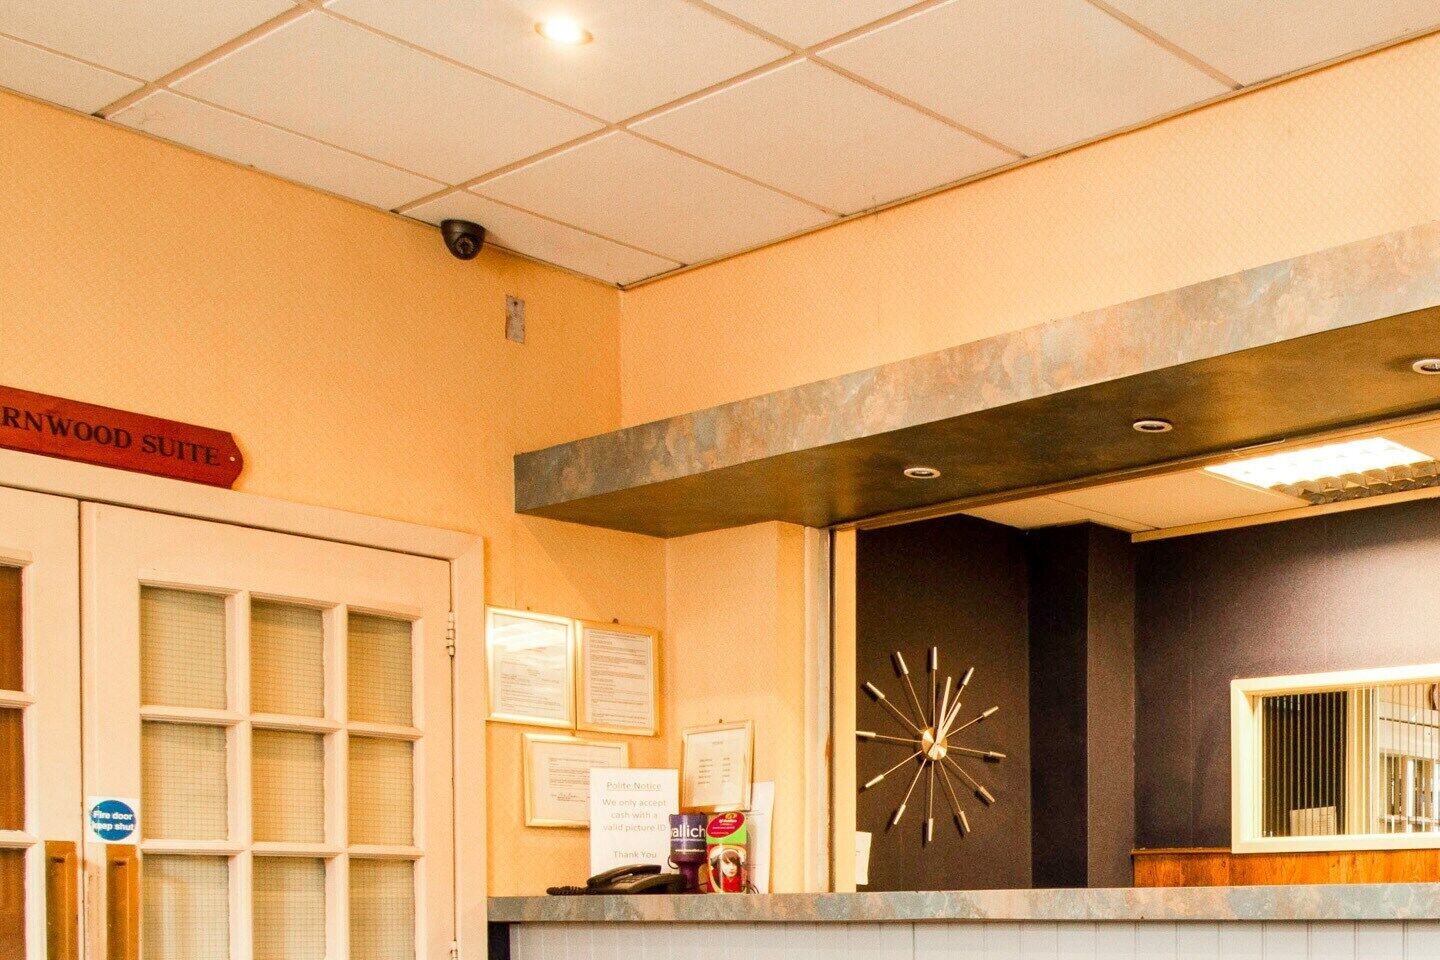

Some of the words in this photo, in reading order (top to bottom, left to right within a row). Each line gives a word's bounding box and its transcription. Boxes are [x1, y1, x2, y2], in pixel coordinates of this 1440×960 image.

[141, 434, 221, 467] SUITE
[606, 782, 631, 791] Polite
[634, 782, 661, 791] Notice
[619, 799, 637, 807] only
[640, 799, 667, 807] accept
[112, 812, 132, 820] door
[611, 811, 630, 819] cash
[632, 811, 651, 819] with
[626, 824, 656, 832] picture
[658, 824, 667, 832] ID
[613, 850, 639, 858] Thank
[641, 850, 657, 858] You
